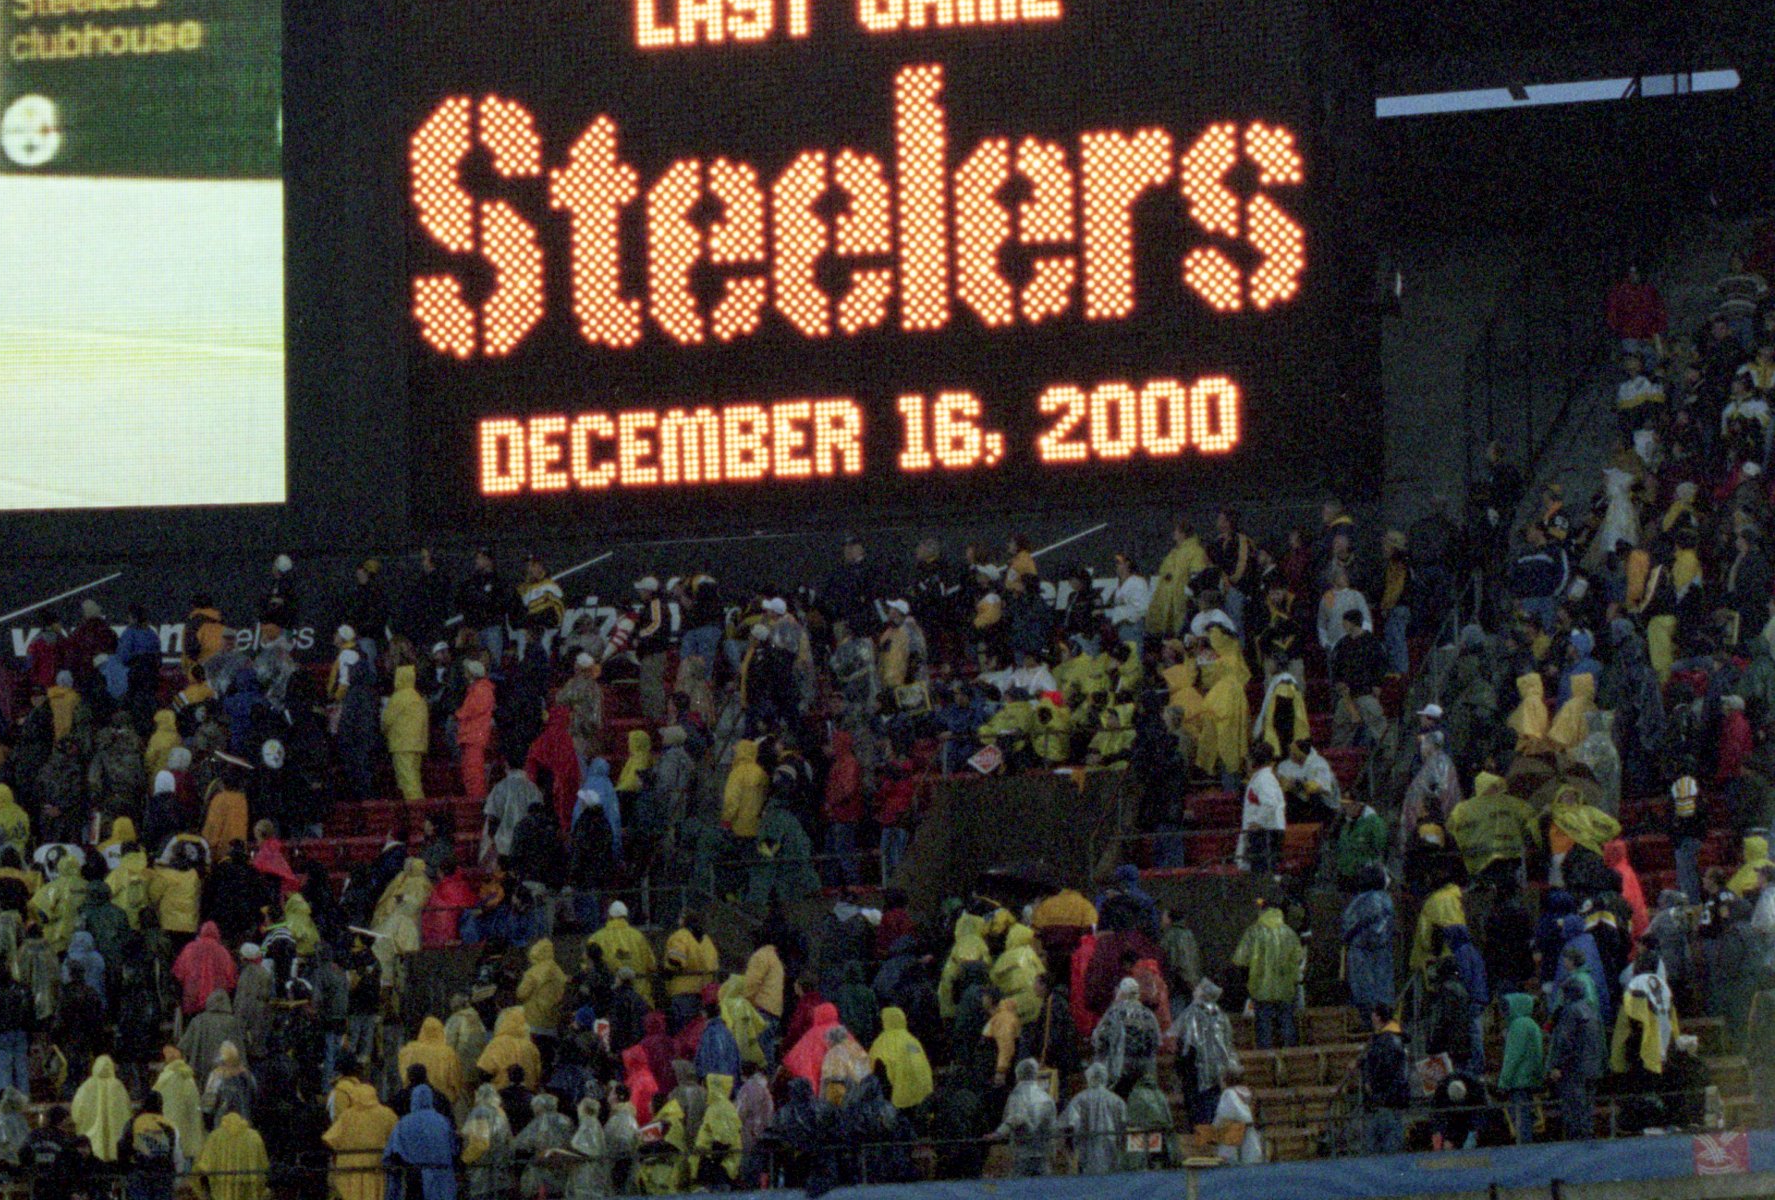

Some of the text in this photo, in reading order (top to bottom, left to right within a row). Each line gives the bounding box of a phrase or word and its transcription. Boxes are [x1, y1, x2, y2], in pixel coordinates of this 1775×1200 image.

[11, 19, 204, 60] clubhouse
[409, 63, 1305, 359] Steelers
[478, 375, 1241, 496] DECEMBER 16, 2000
